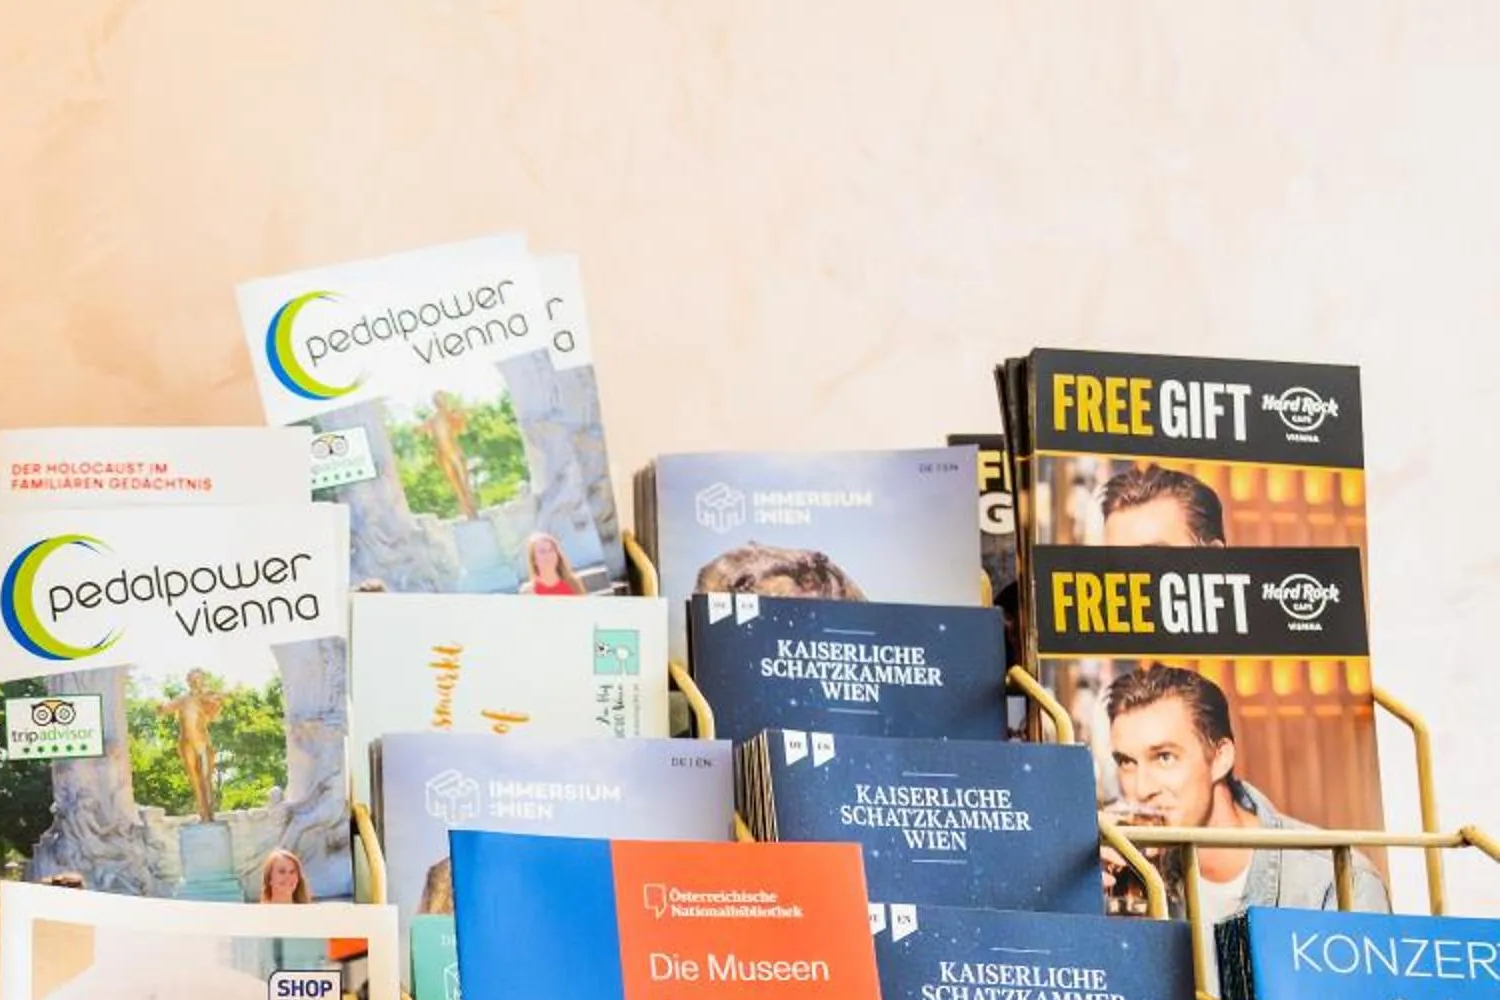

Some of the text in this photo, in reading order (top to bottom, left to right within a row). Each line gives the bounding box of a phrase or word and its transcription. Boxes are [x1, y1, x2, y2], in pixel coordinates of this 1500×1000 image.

[305, 279, 514, 366] pedalpower
[413, 312, 529, 365] vienna
[1052, 373, 1339, 442] FREE GIFT Hard Rock
[11, 463, 168, 475] DER HOLOCAUST IM
[49, 551, 313, 622] pedalpower
[175, 592, 321, 637] vienna
[1051, 571, 1340, 635] FREE GIFT Hard Rock
[776, 640, 926, 666] KAISERLICHE
[761, 658, 944, 686] SCHATZKAMMER
[820, 681, 881, 703] WIEN
[11, 727, 95, 744] tripadvisor
[488, 780, 622, 801] IMMERSIUM
[855, 784, 1012, 809] KAISERLICHE
[840, 805, 1033, 833] SCHATZKAMMER
[902, 828, 968, 852] WIEN
[650, 953, 830, 983] Die Museen
[1291, 931, 1500, 981] KONZER
[276, 979, 333, 998] SHOP
[939, 960, 1107, 991] KAISERLICHE
